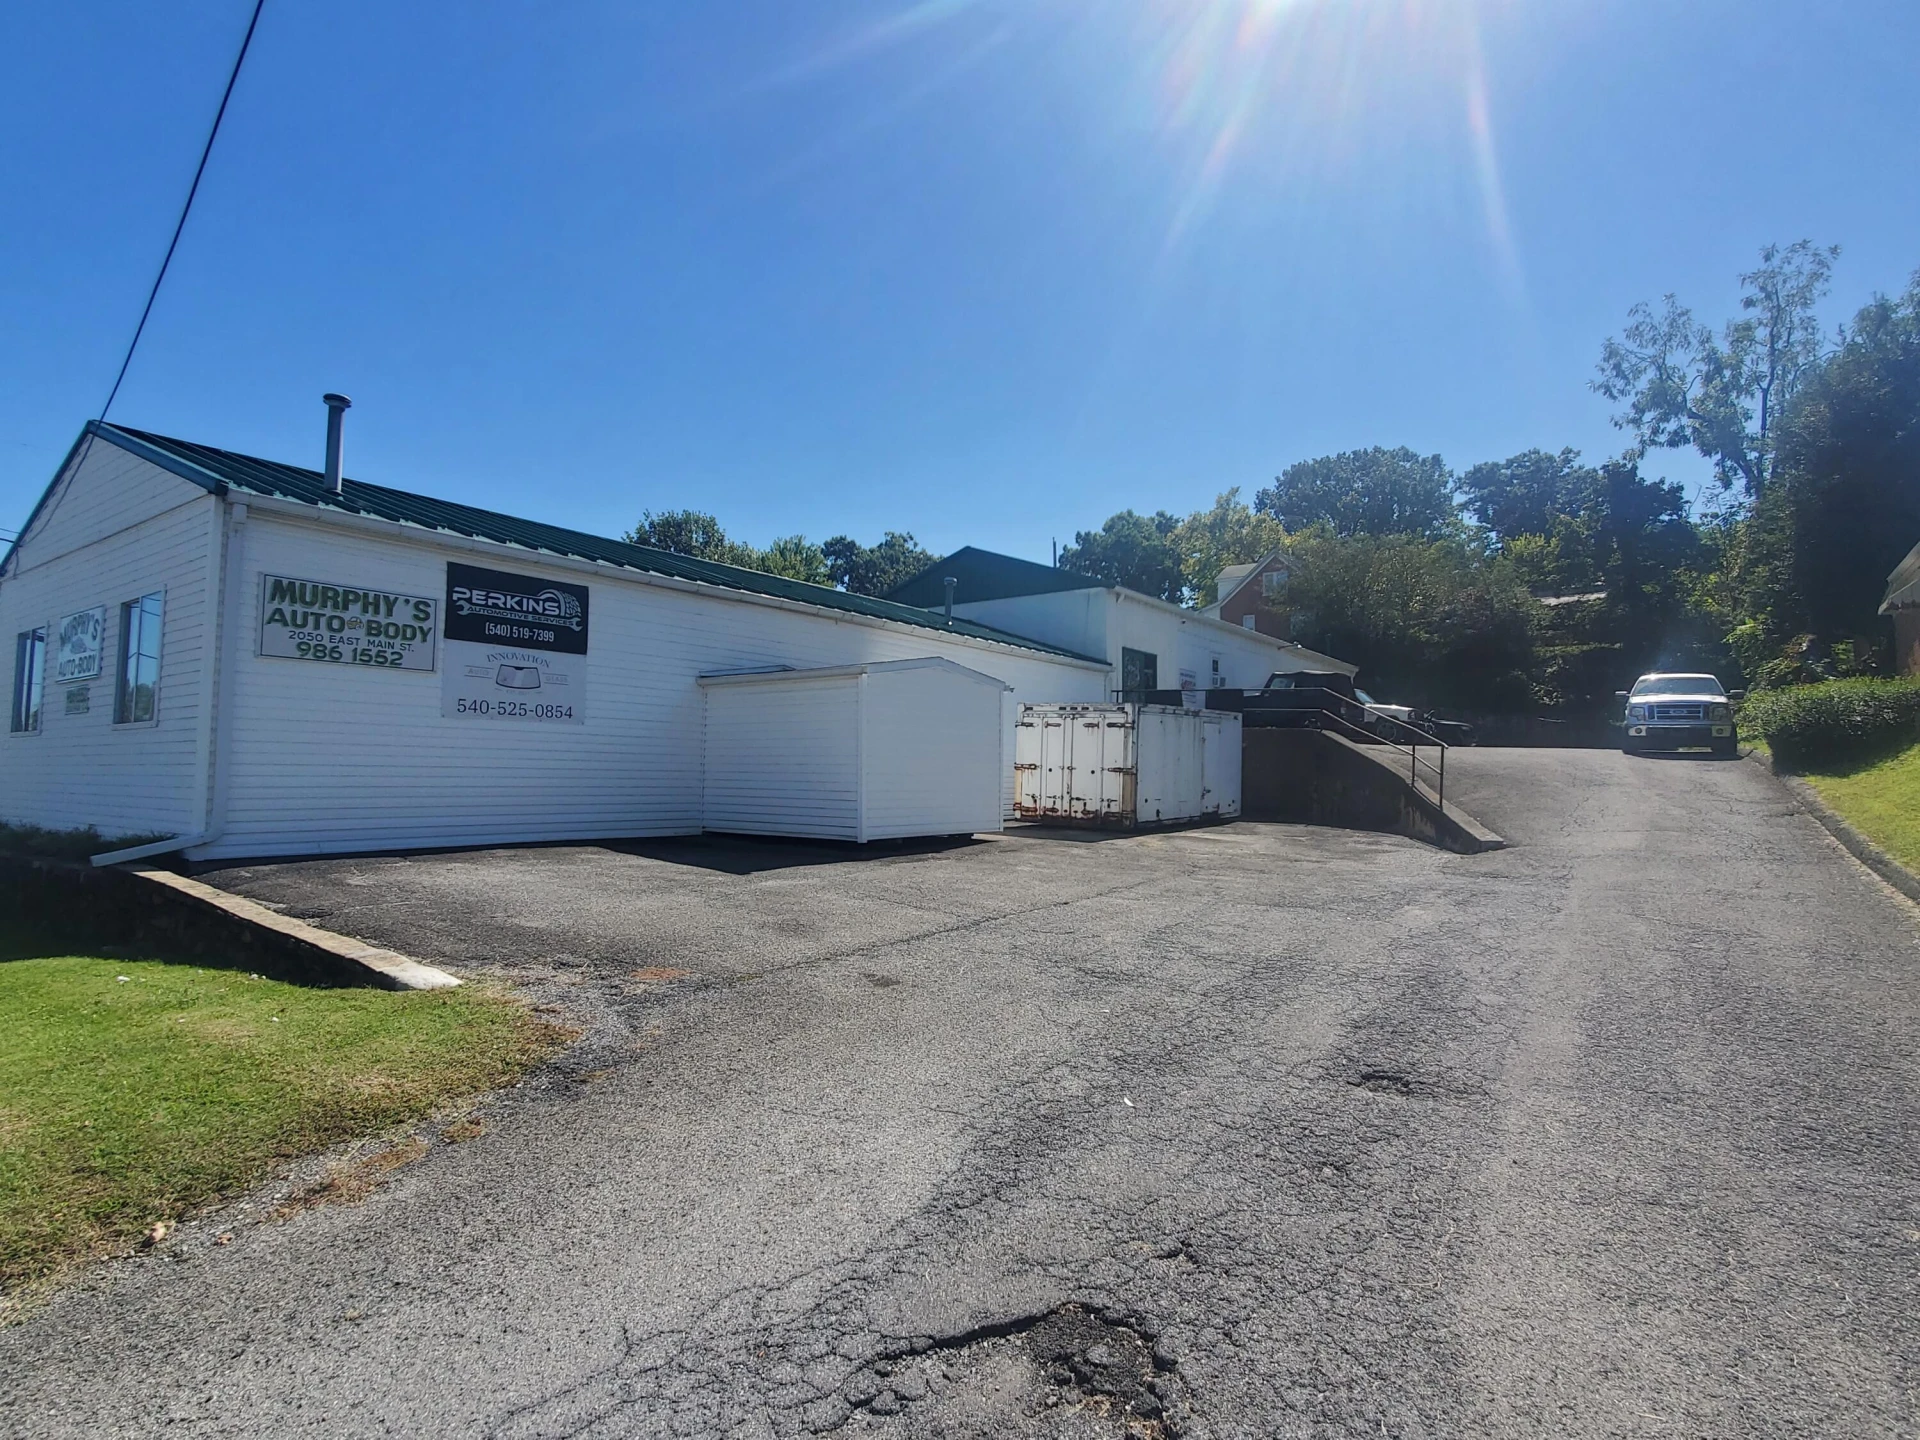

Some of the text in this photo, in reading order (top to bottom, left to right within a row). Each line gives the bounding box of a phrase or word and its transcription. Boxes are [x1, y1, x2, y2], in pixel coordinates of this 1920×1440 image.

[267, 578, 432, 622] MURPHY'S
[452, 586, 560, 616] PERKINS
[265, 607, 432, 643] AUTO BODY
[468, 606, 574, 626] AUTOMOTIVE SERVICES
[288, 631, 415, 652] 2050 EAST MAIN ST.
[485, 622, 555, 642] (540) 519-7399
[296, 641, 404, 666] 986 1552
[486, 652, 551, 668] INNOVATION
[457, 698, 573, 719] 540-525-0854
